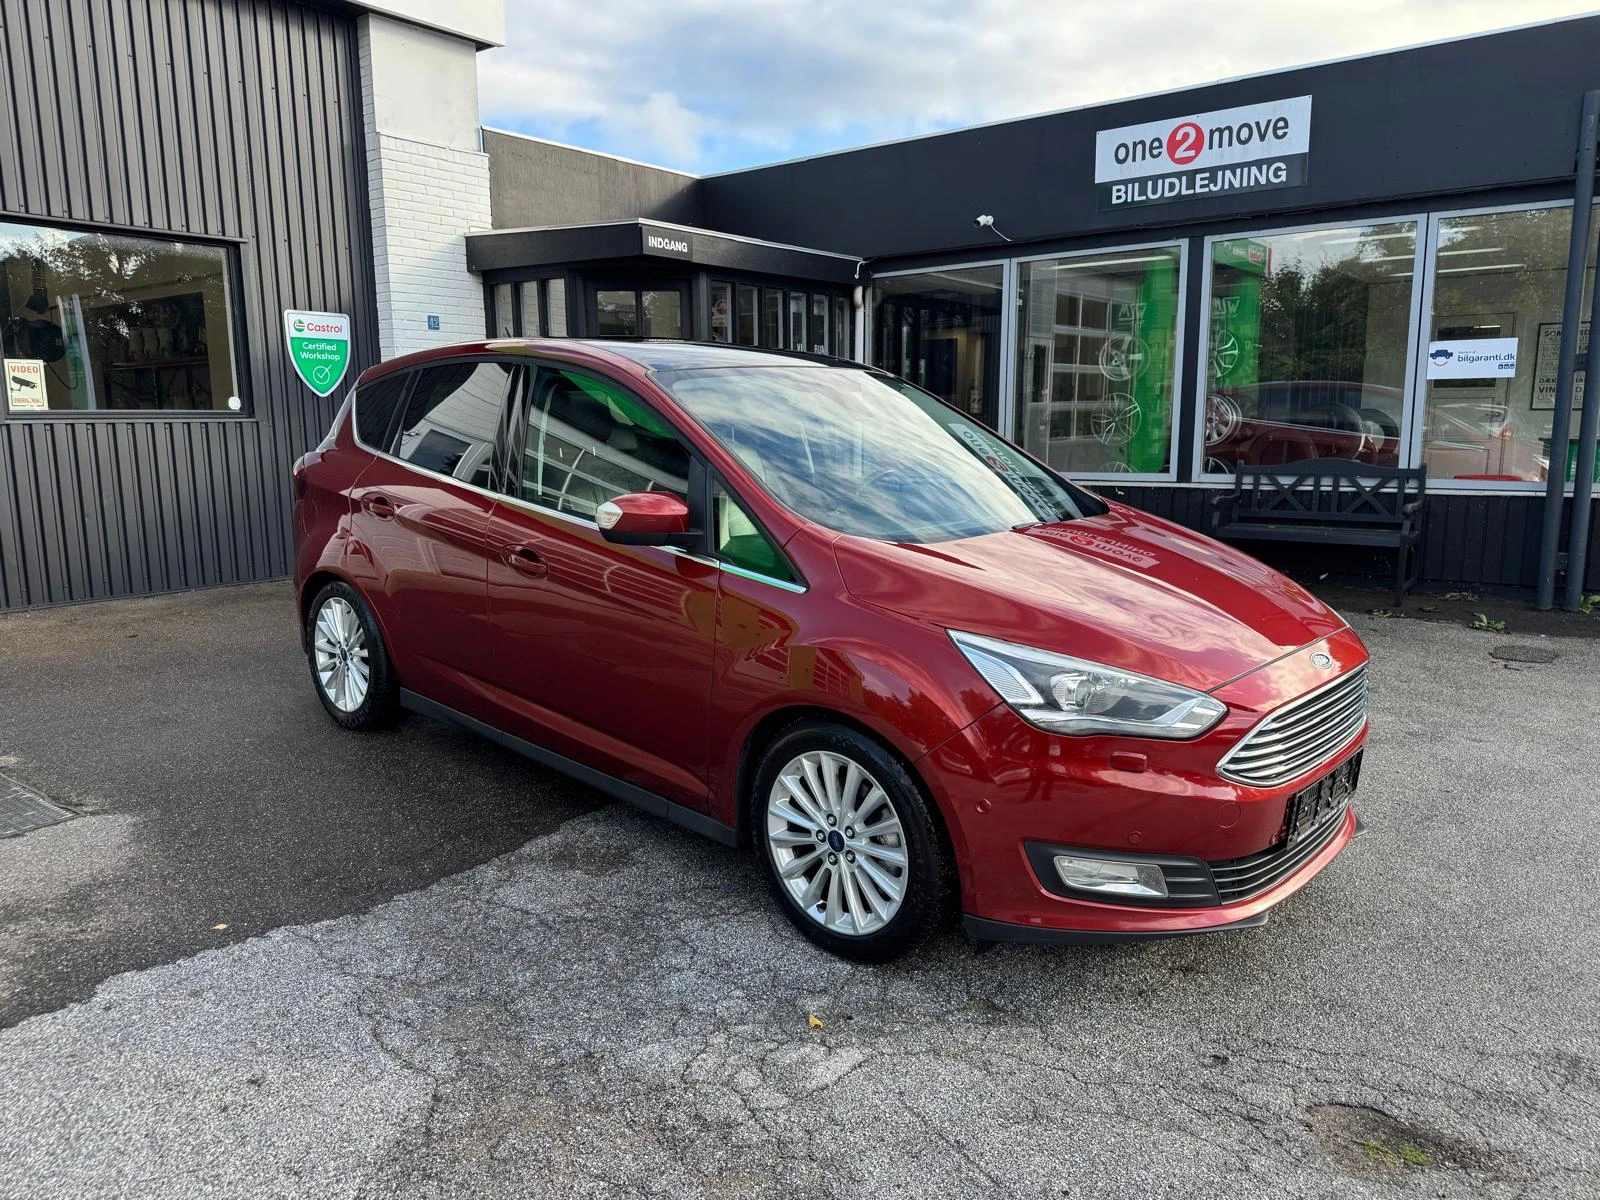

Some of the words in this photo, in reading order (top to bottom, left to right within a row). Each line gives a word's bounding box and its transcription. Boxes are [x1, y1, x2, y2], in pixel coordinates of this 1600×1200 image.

[1111, 162, 1287, 205] BILUDLEJNING
[648, 236, 688, 253] INDGANG
[306, 322, 343, 333] Castrol
[302, 342, 337, 351] Certified
[300, 351, 341, 362] Workshop
[1457, 353, 1516, 364] bilgaranti.dk
[10, 365, 39, 373] VIDEO
